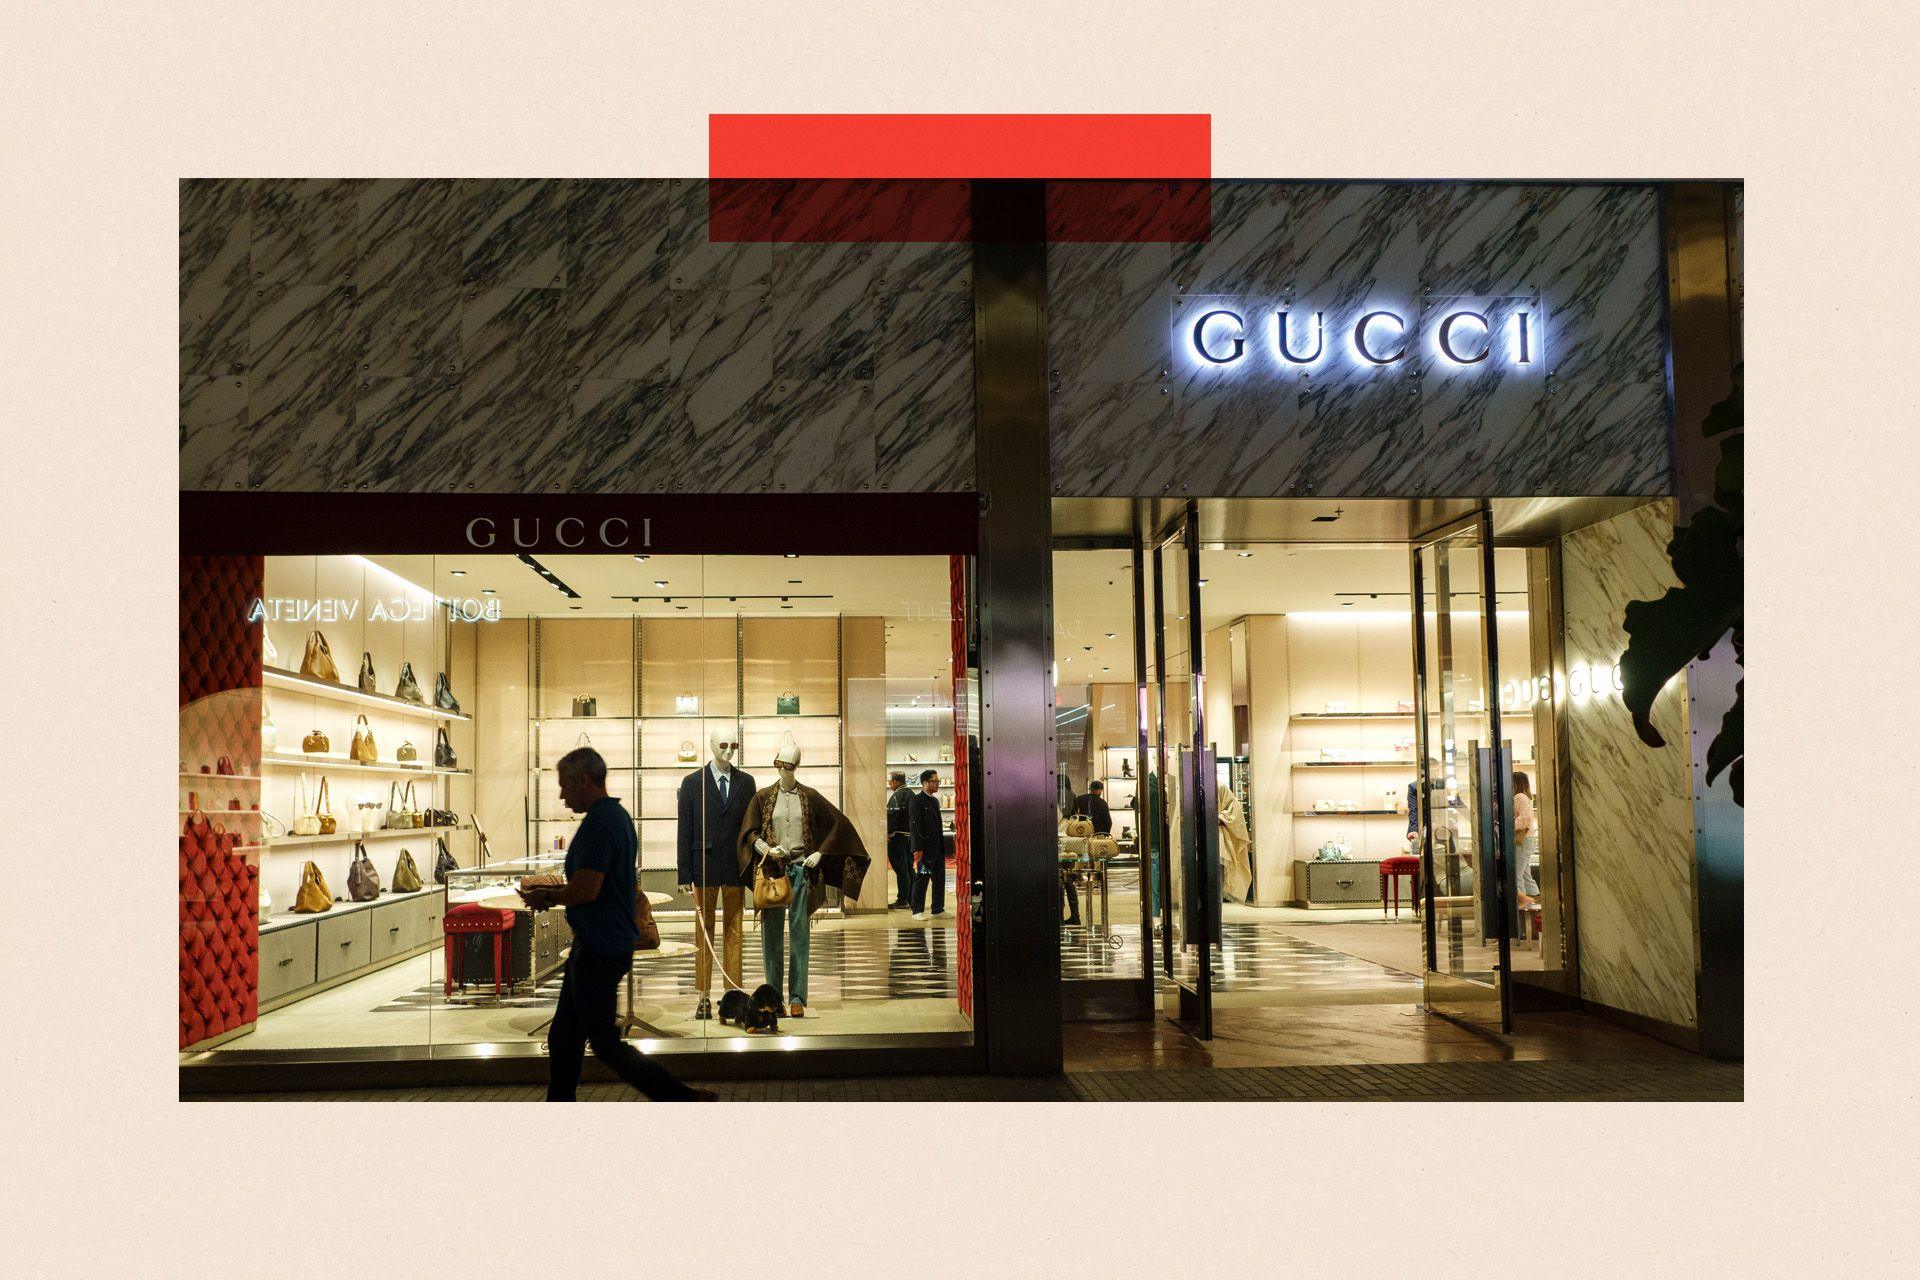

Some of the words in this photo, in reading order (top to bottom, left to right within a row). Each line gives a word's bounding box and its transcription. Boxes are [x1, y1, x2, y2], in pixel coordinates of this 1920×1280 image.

[1192, 309, 1531, 365] GUCCI
[465, 517, 651, 548] GUCCI
[1568, 663, 1624, 697] GUC
